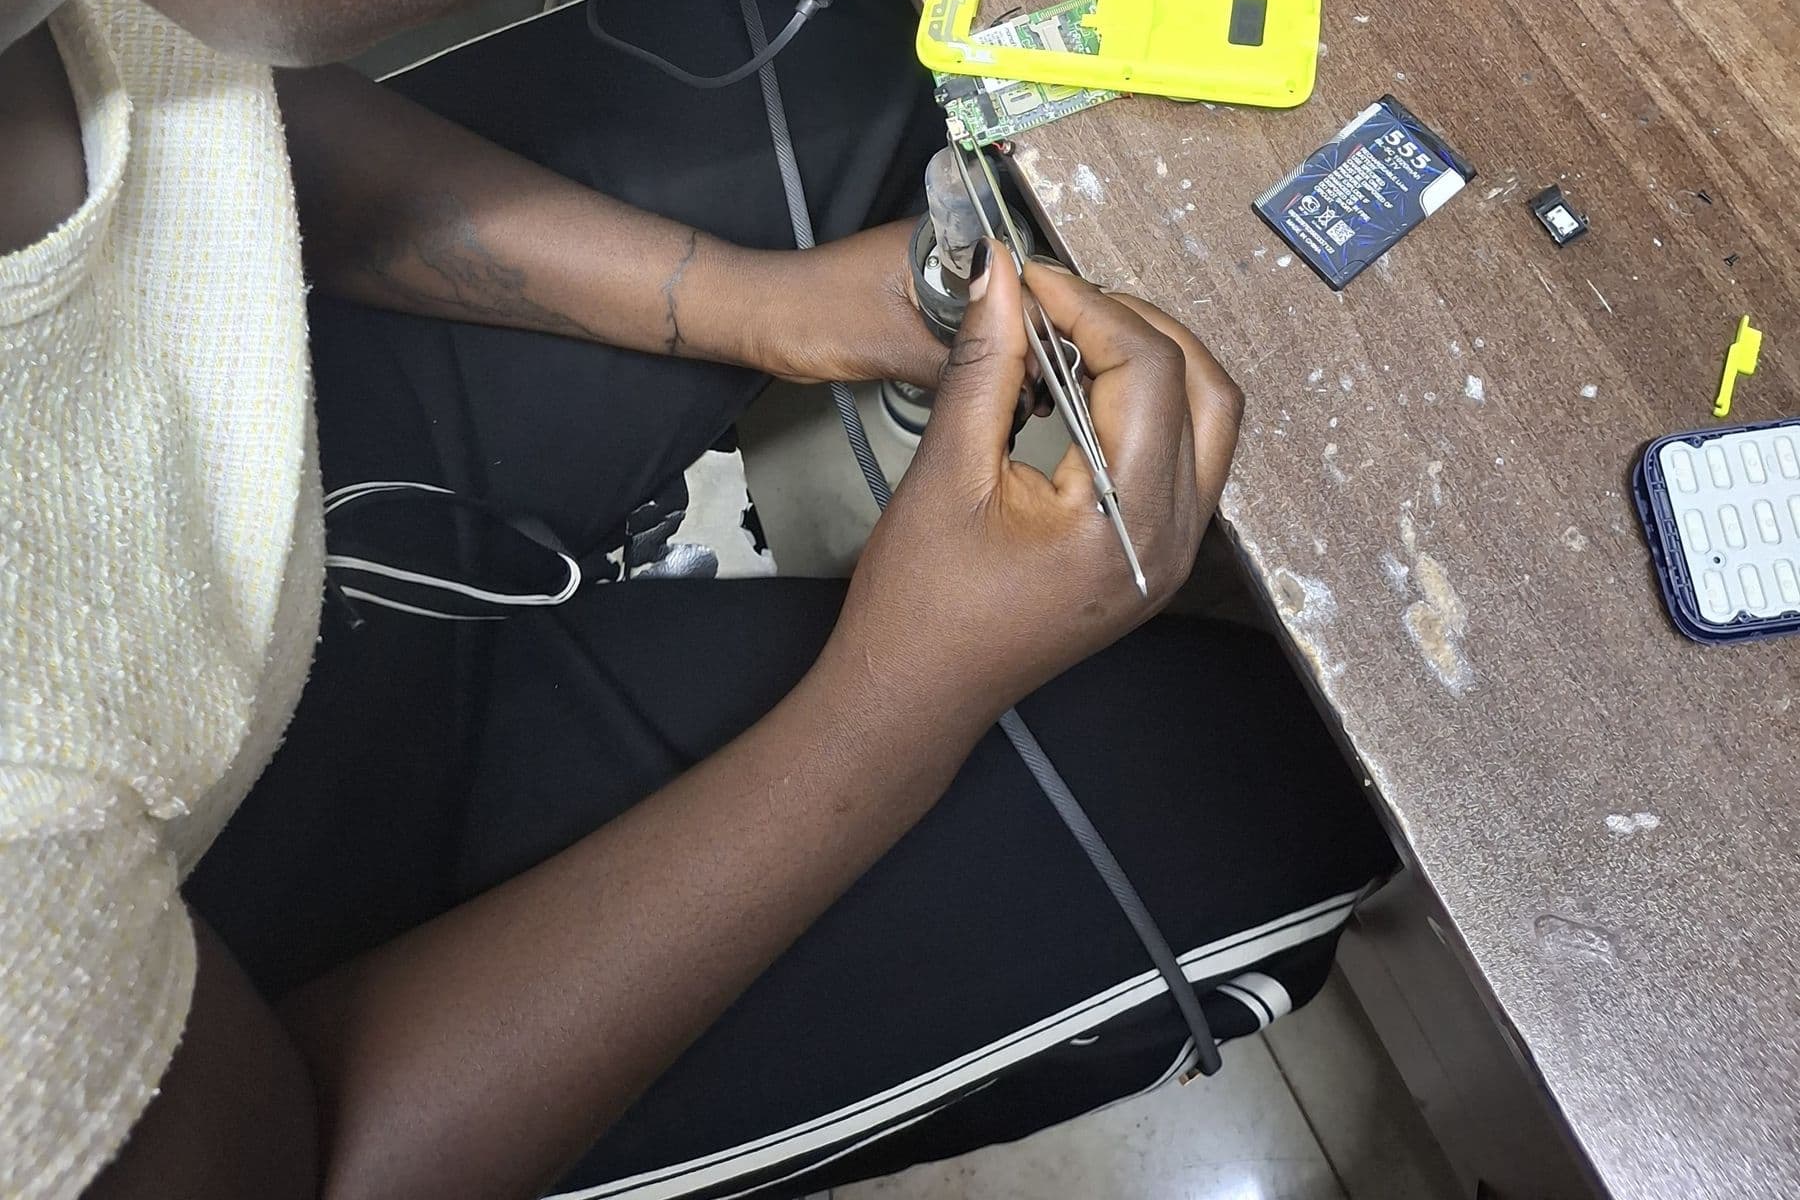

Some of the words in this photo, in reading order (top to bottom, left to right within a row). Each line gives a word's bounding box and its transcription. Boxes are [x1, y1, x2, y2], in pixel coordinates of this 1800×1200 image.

[1355, 150, 1377, 170] BATTERY
[1386, 130, 1430, 169] 555
[1360, 146, 1397, 181] RECHARGEABLE
[1392, 154, 1421, 180] 1020mAh
[1318, 180, 1328, 189] DO
[1325, 187, 1337, 198] NOT
[1341, 178, 1365, 200] EXPLODE
[1383, 200, 1393, 209] OF
[1285, 218, 1301, 233] MADE
[1304, 237, 1322, 254] CHINA
